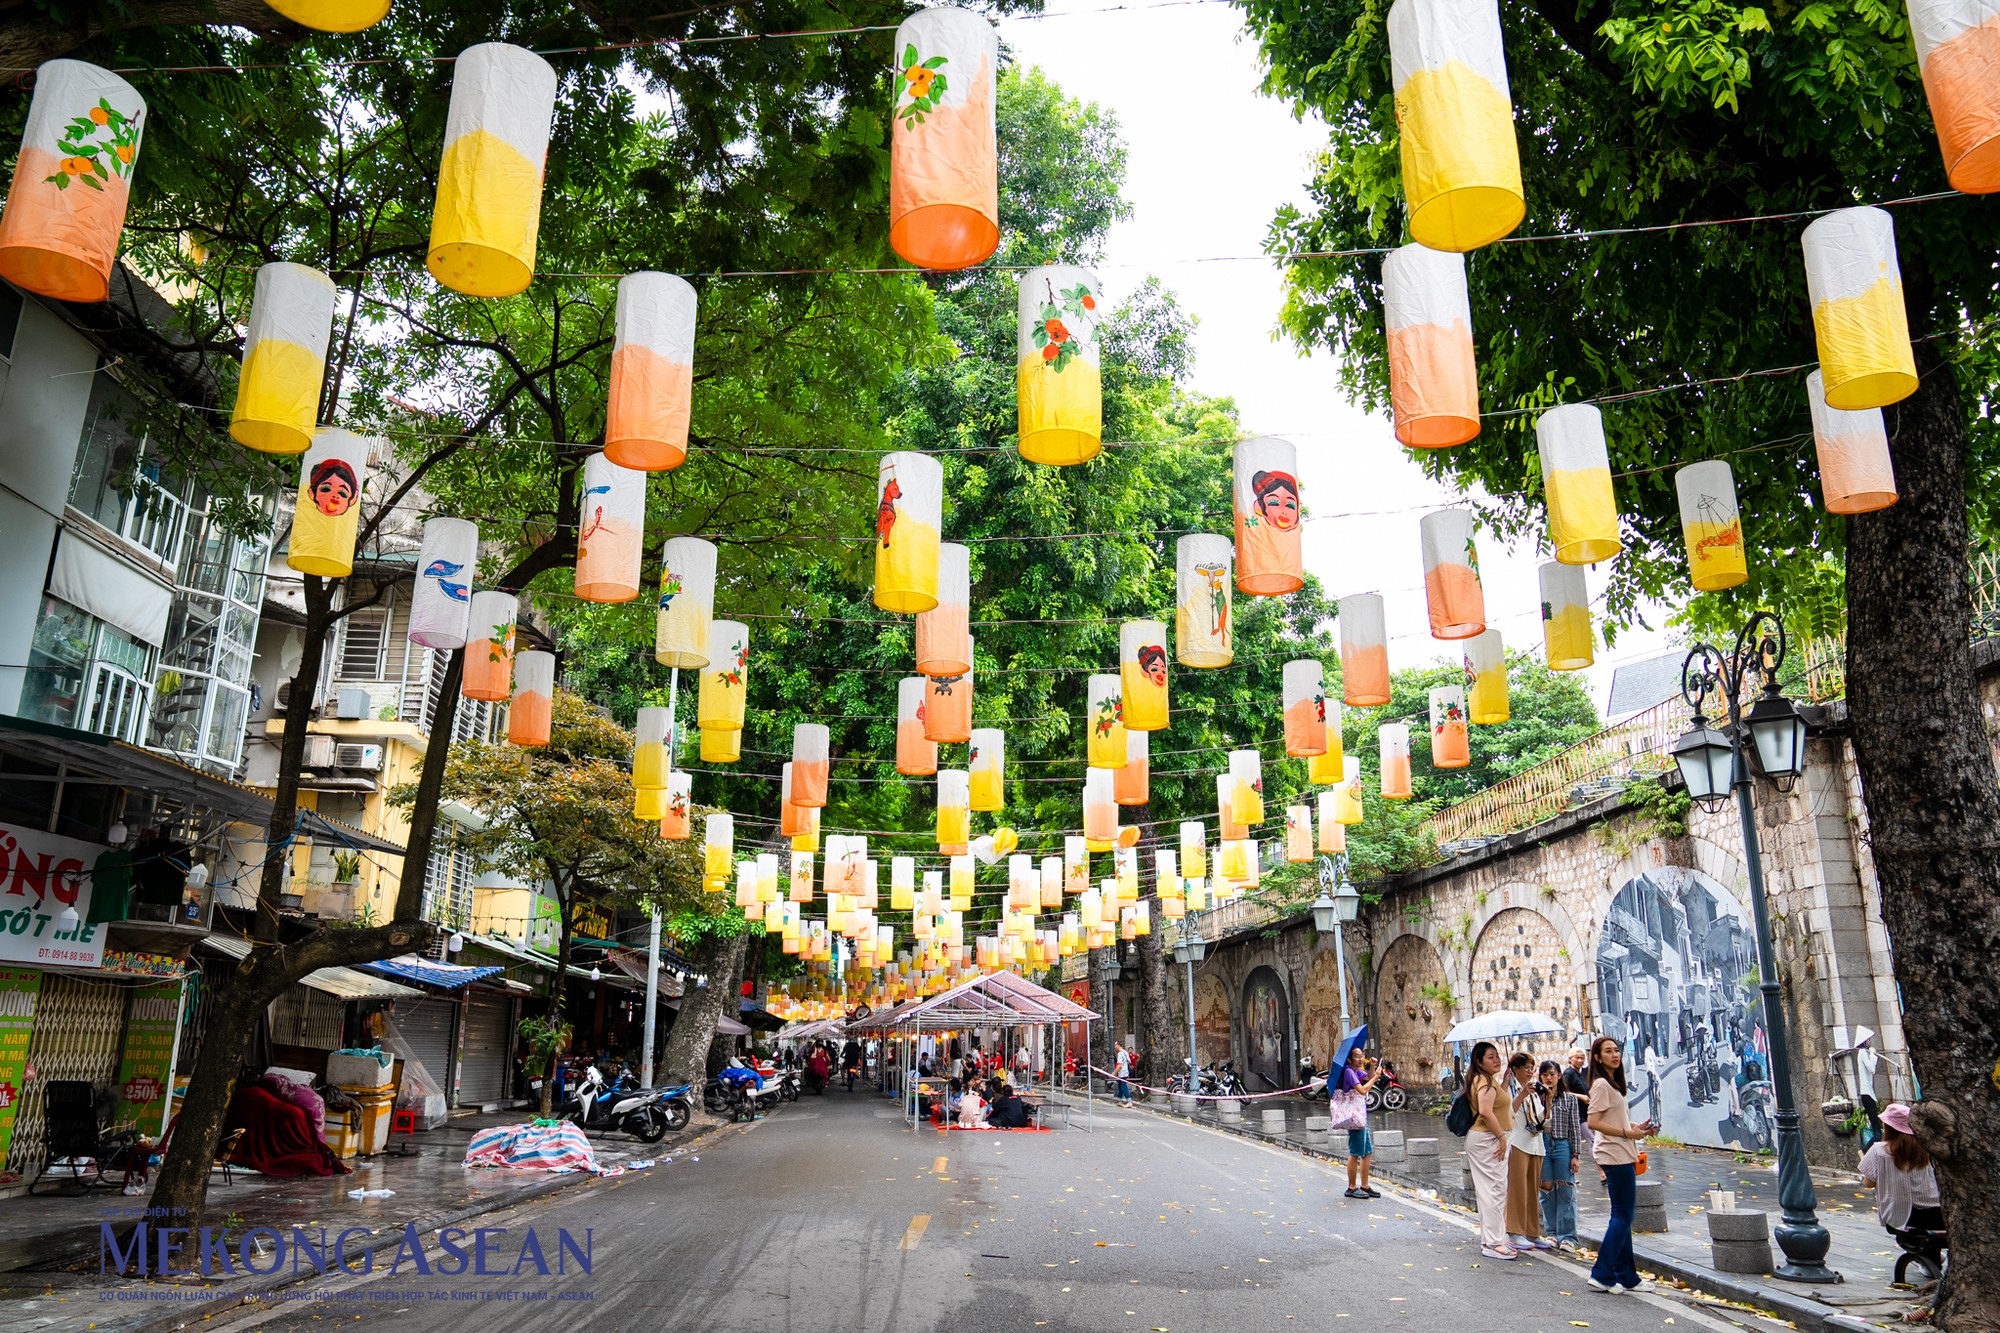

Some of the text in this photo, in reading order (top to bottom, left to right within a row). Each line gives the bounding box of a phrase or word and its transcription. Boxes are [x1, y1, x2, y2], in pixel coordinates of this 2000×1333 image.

[52, 949, 69, 960] 0914
[69, 951, 77, 960] 88
[79, 952, 94, 962] 9938
